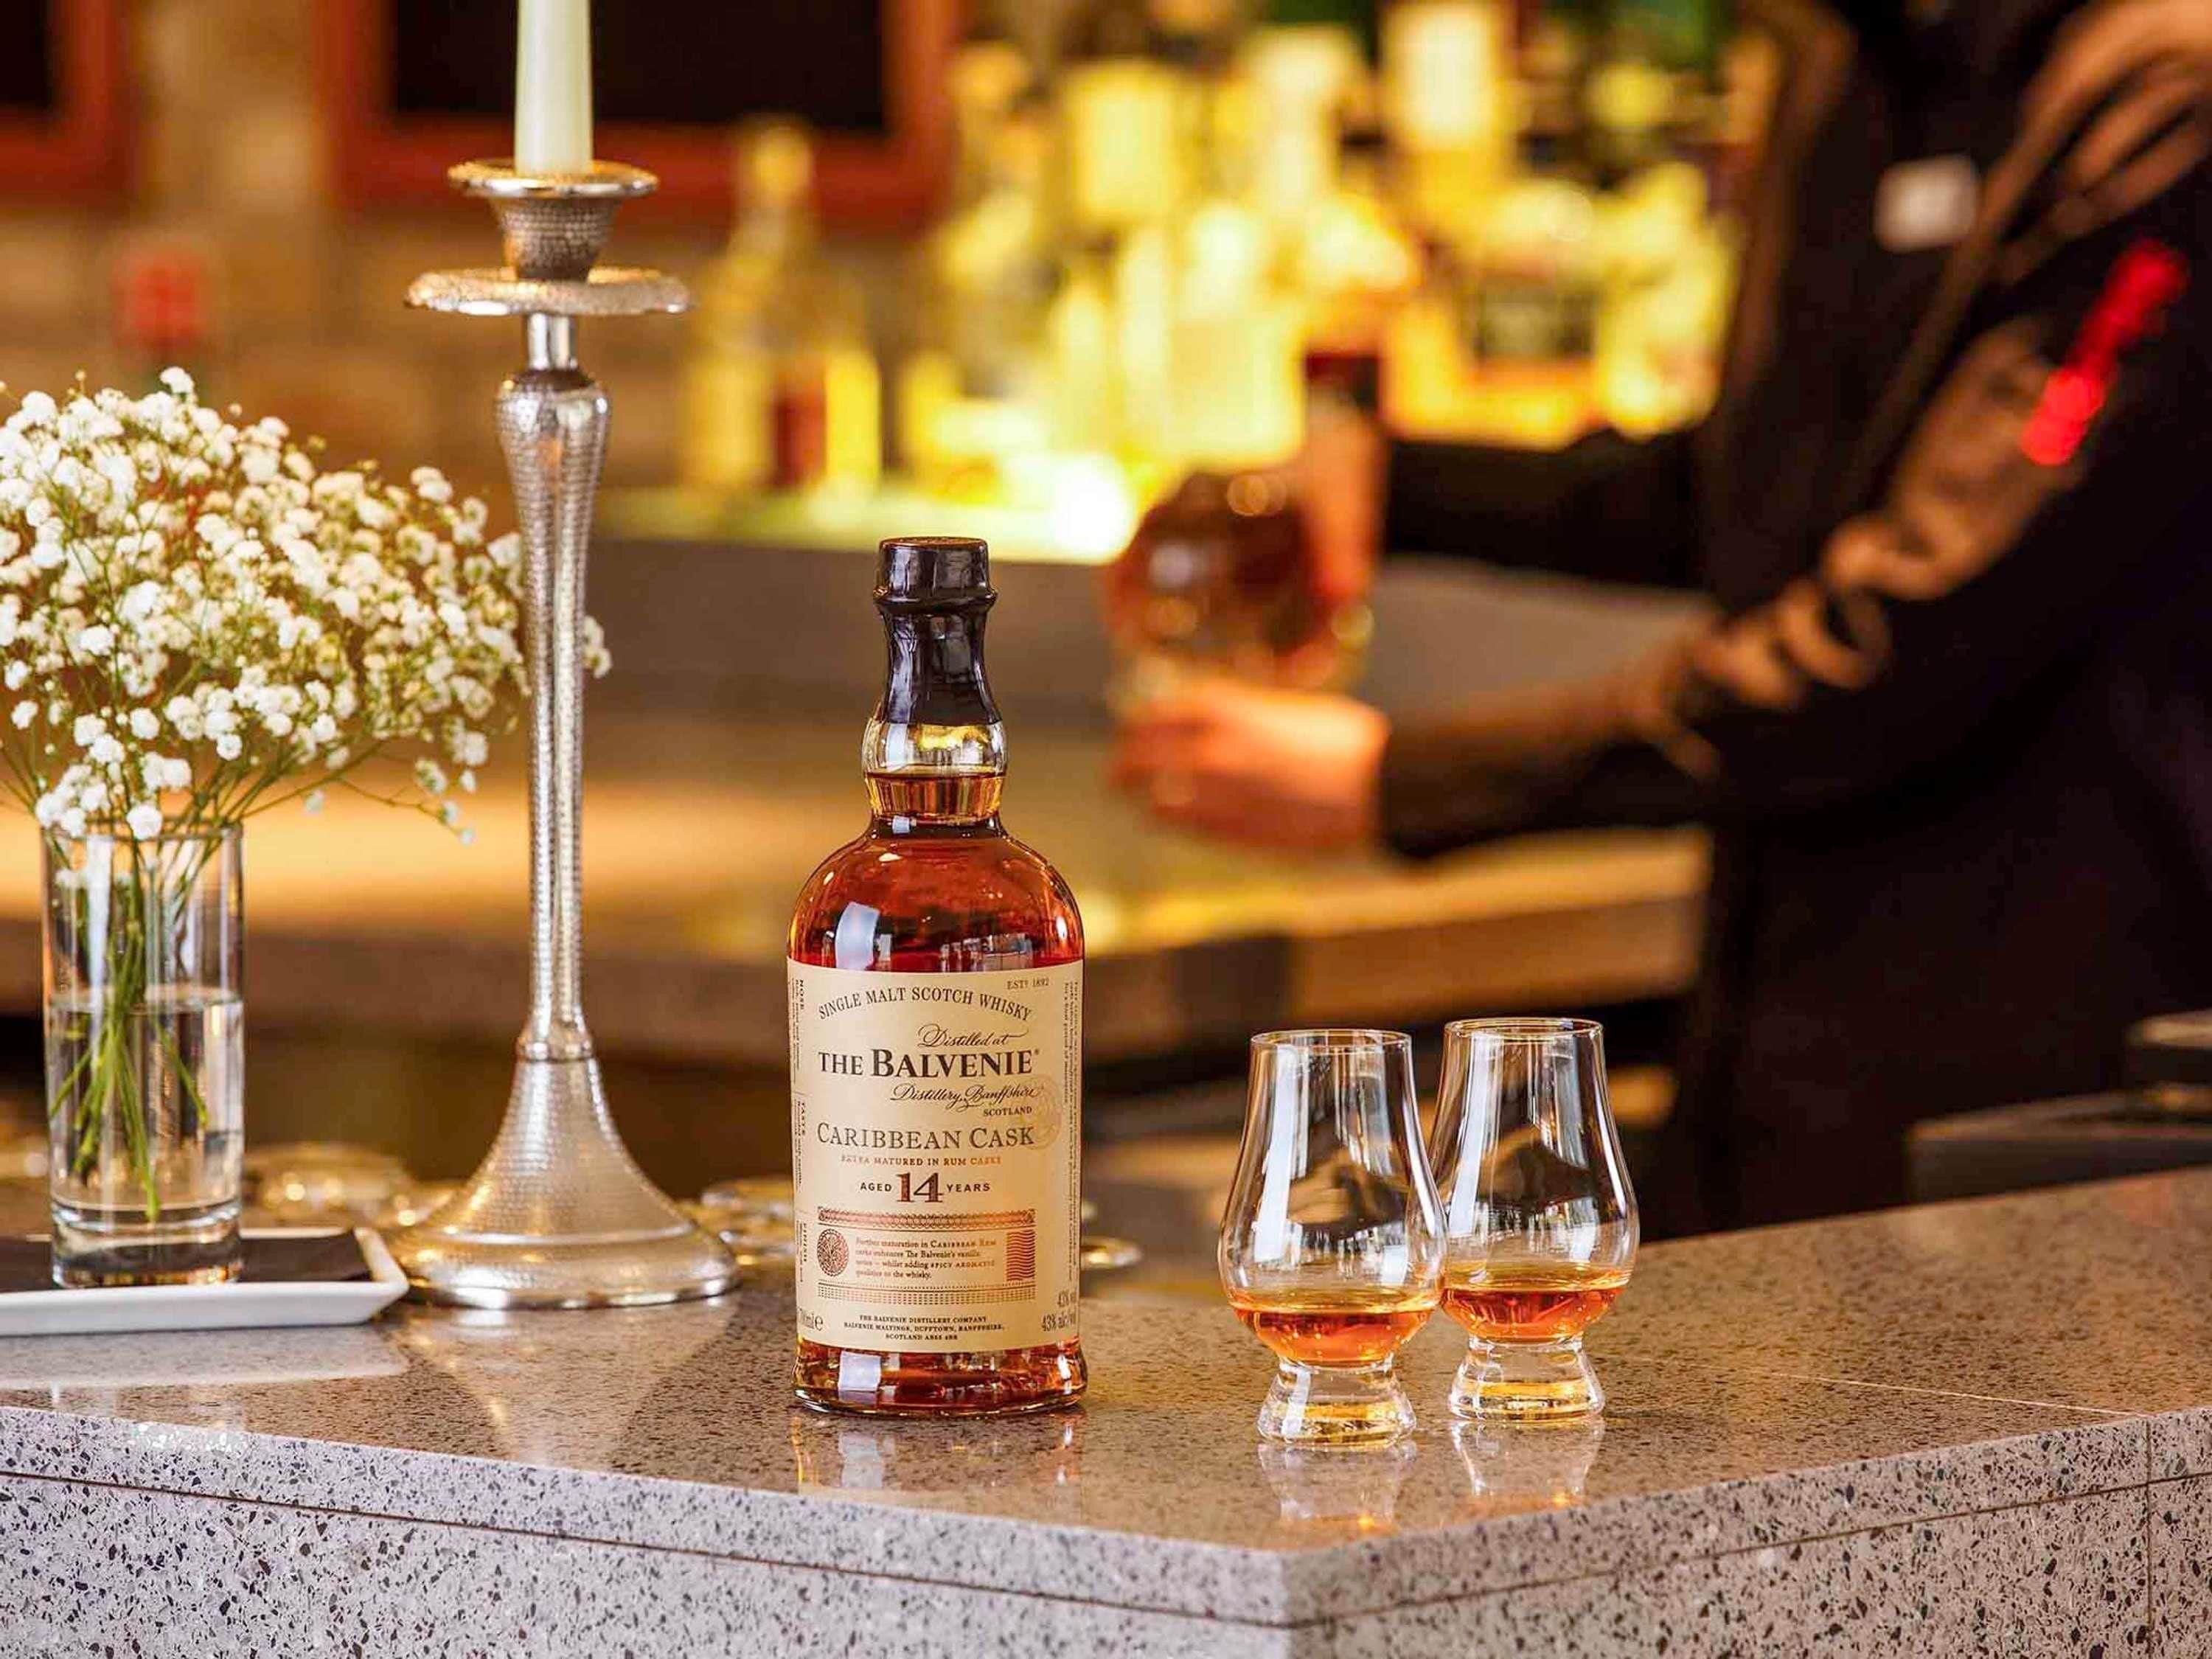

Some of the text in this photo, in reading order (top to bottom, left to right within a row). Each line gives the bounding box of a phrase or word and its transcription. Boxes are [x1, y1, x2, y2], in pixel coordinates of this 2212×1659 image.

[1032, 978, 1050, 988] 1892
[818, 987, 1032, 1020] SINGLE MALT SCOTCH WHISKY
[917, 1023, 991, 1047] Distilled
[818, 1051, 863, 1076] THE
[983, 1106, 1032, 1116] SCOTLAND
[817, 1122, 1034, 1149] CARIBBEAN CASK
[841, 1155, 1002, 1166] EXTRA MATURED IN RUM CASKS
[860, 1172, 991, 1203] AGED 14 YEARS
[882, 1239, 919, 1248] maturation
[905, 1250, 917, 1258] The
[905, 1261, 928, 1270] adding
[893, 1270, 903, 1278] the
[905, 1270, 932, 1280] whisky.
